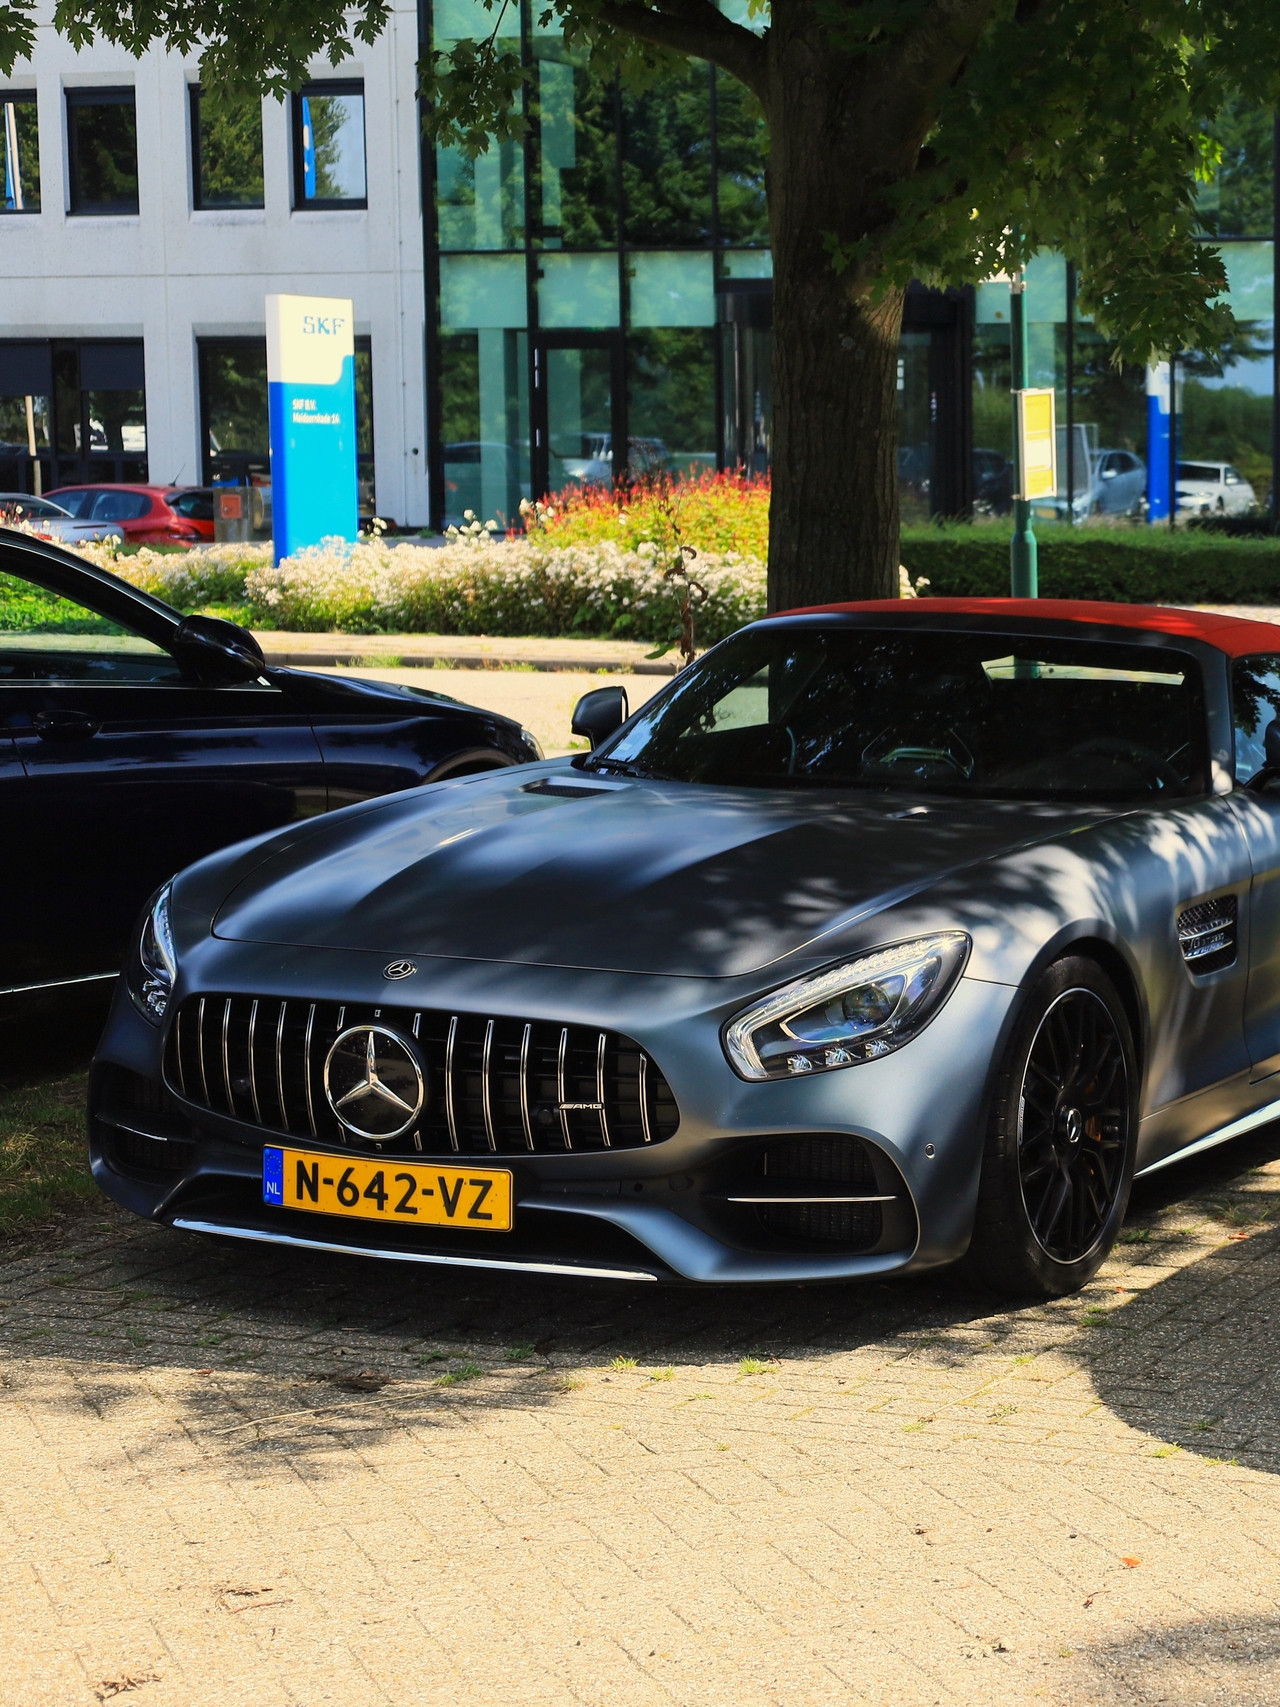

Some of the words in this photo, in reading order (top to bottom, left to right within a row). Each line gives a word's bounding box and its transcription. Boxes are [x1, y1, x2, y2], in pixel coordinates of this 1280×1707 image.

[303, 315, 345, 335] SKF
[266, 1181, 280, 1195] NL
[296, 1160, 493, 1221] N-642-VZ
